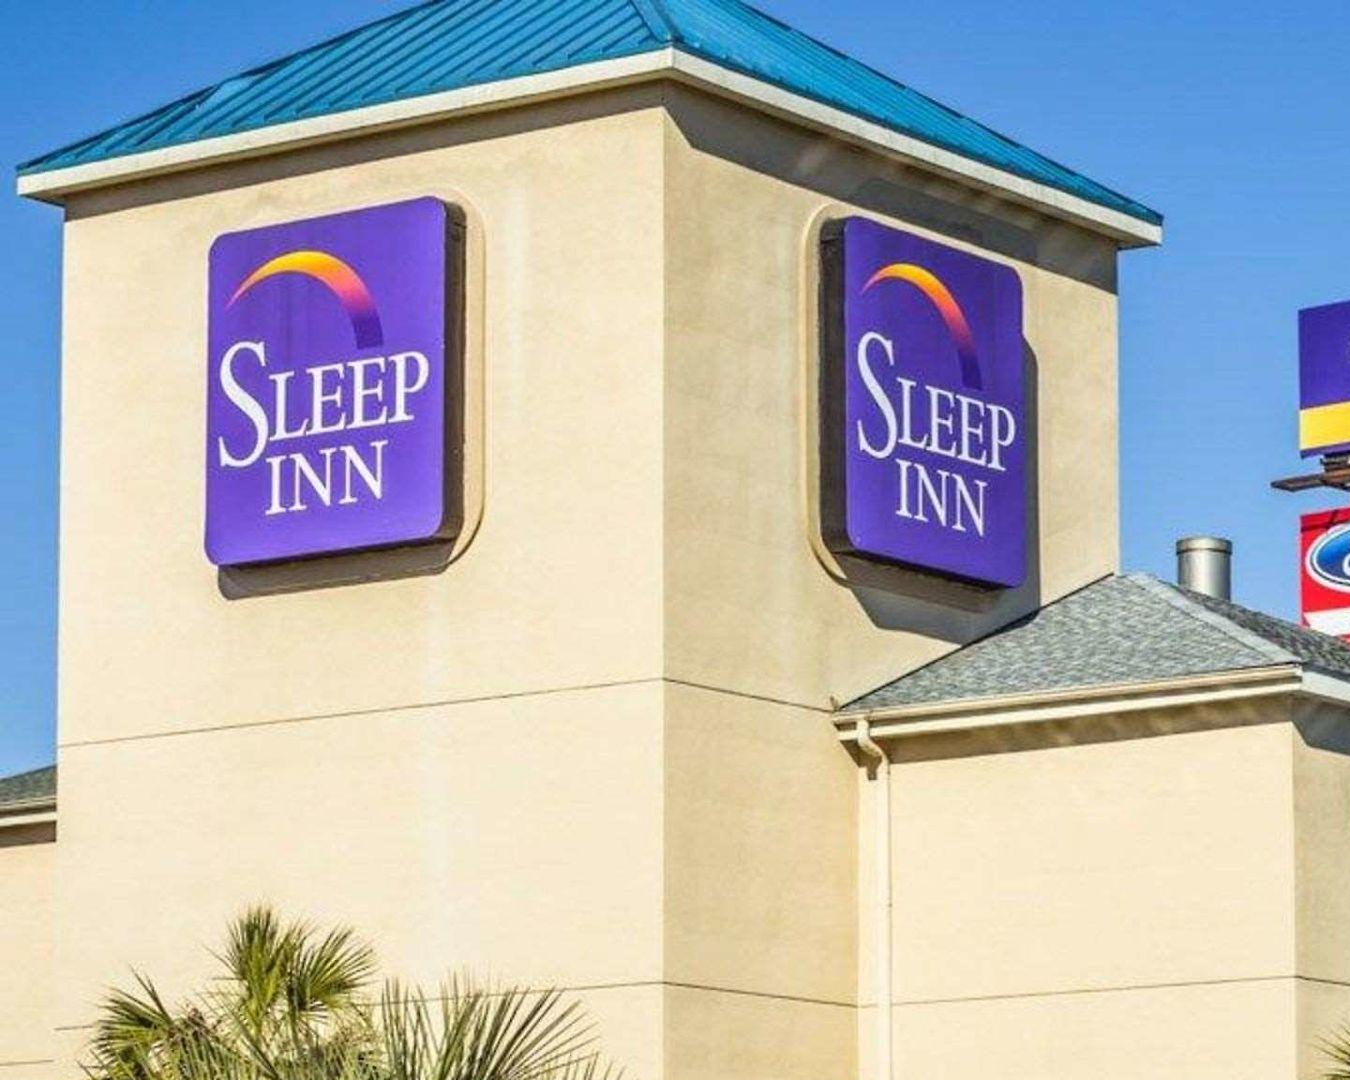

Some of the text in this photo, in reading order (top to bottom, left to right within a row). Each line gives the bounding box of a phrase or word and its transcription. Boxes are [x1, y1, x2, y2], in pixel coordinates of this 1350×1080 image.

[218, 340, 430, 468] SLEEP
[857, 331, 1017, 472] SLEEP
[264, 440, 390, 516] INN
[895, 458, 989, 538] INN
